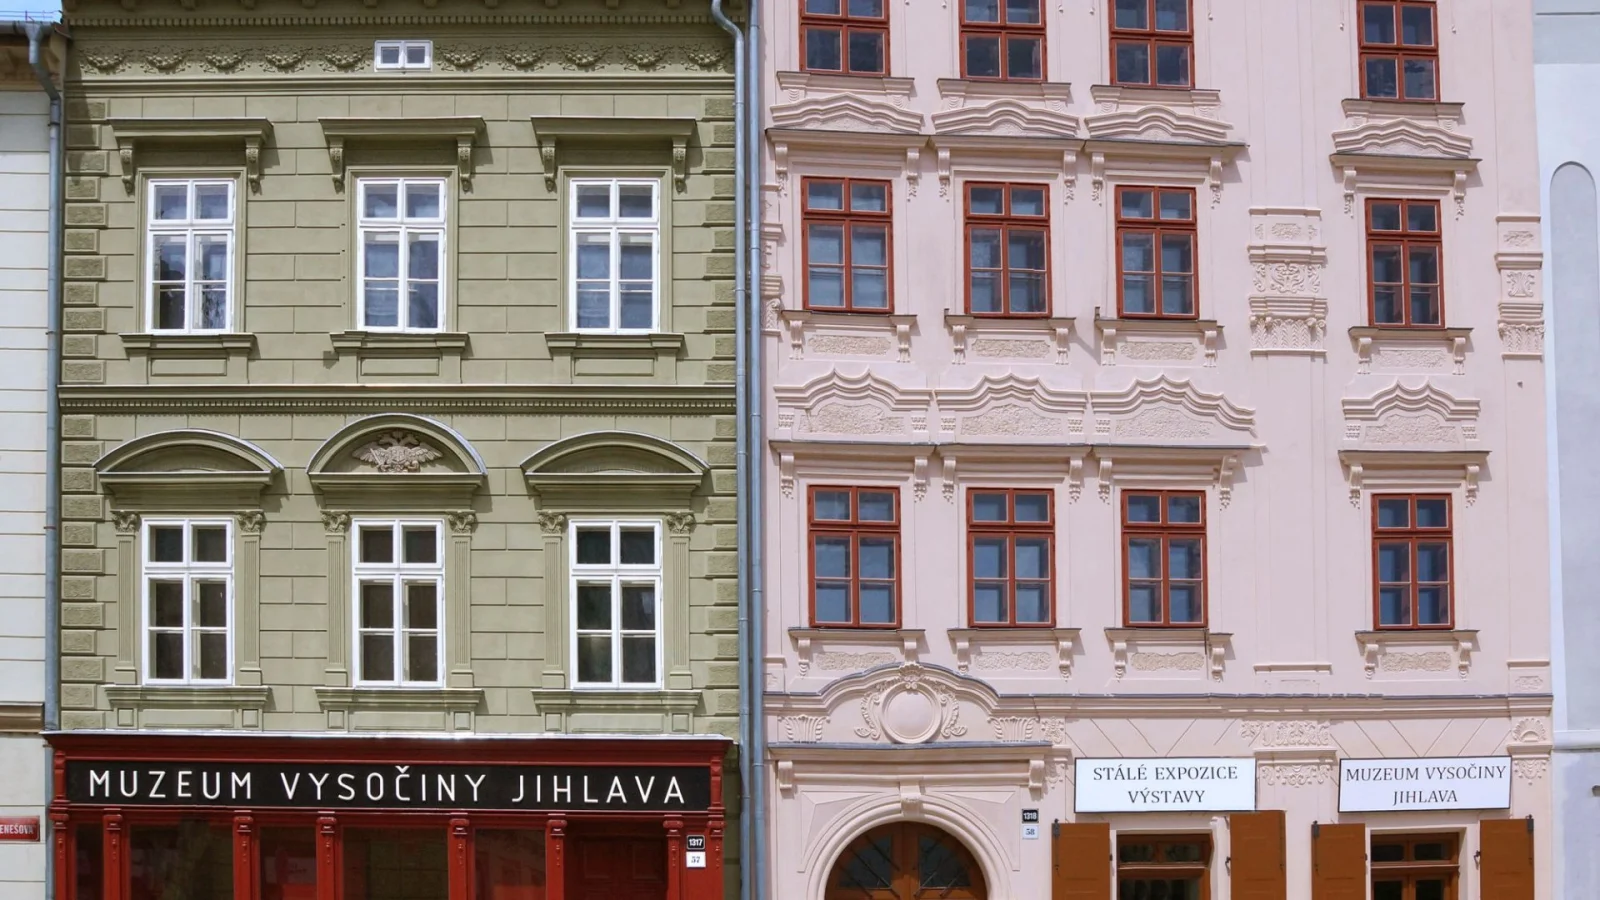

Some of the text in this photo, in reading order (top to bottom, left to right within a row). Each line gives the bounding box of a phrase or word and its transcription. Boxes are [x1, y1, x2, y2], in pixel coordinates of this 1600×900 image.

[1093, 764, 1238, 781] STÁLÉ EXPOZICE
[1346, 763, 1507, 782] MUZEUM VYSOČINY
[89, 765, 685, 804] MUZEUM VYSOČINY JIHLAVA
[1127, 787, 1206, 804] VÝSTAVY
[1392, 789, 1459, 807] JIHLAVA
[1023, 812, 1037, 820] 1318
[688, 838, 703, 847] 1317
